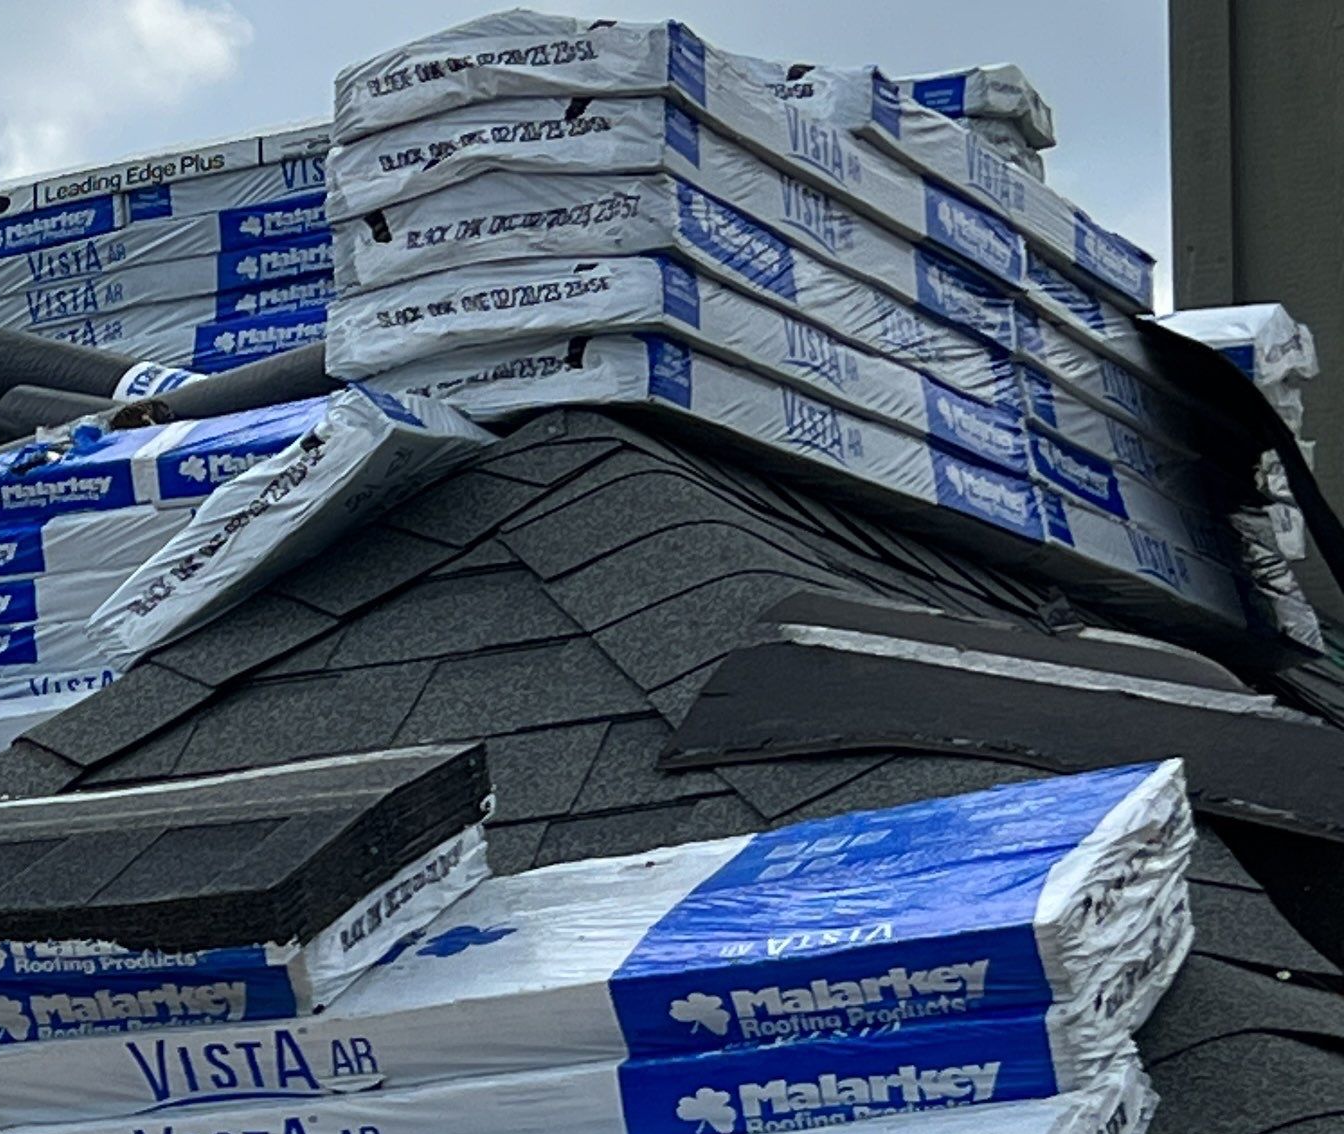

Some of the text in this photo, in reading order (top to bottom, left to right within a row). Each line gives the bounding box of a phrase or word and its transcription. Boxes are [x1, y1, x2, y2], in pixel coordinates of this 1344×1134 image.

[784, 105, 846, 185] VISTA
[45, 171, 122, 203] Leading
[126, 163, 177, 187] Edge
[180, 152, 226, 175] Plus
[27, 241, 103, 282] VISTA
[26, 280, 100, 324] VISTA
[1, 475, 114, 500] Malarkey
[13, 952, 198, 975] Roofing Products
[29, 981, 247, 1025] Malarkey
[729, 958, 990, 1020] Malarkey
[738, 995, 968, 1039] Roofing Products
[125, 1028, 380, 1101] VISTA AR
[738, 1061, 1002, 1118] Malarkey
